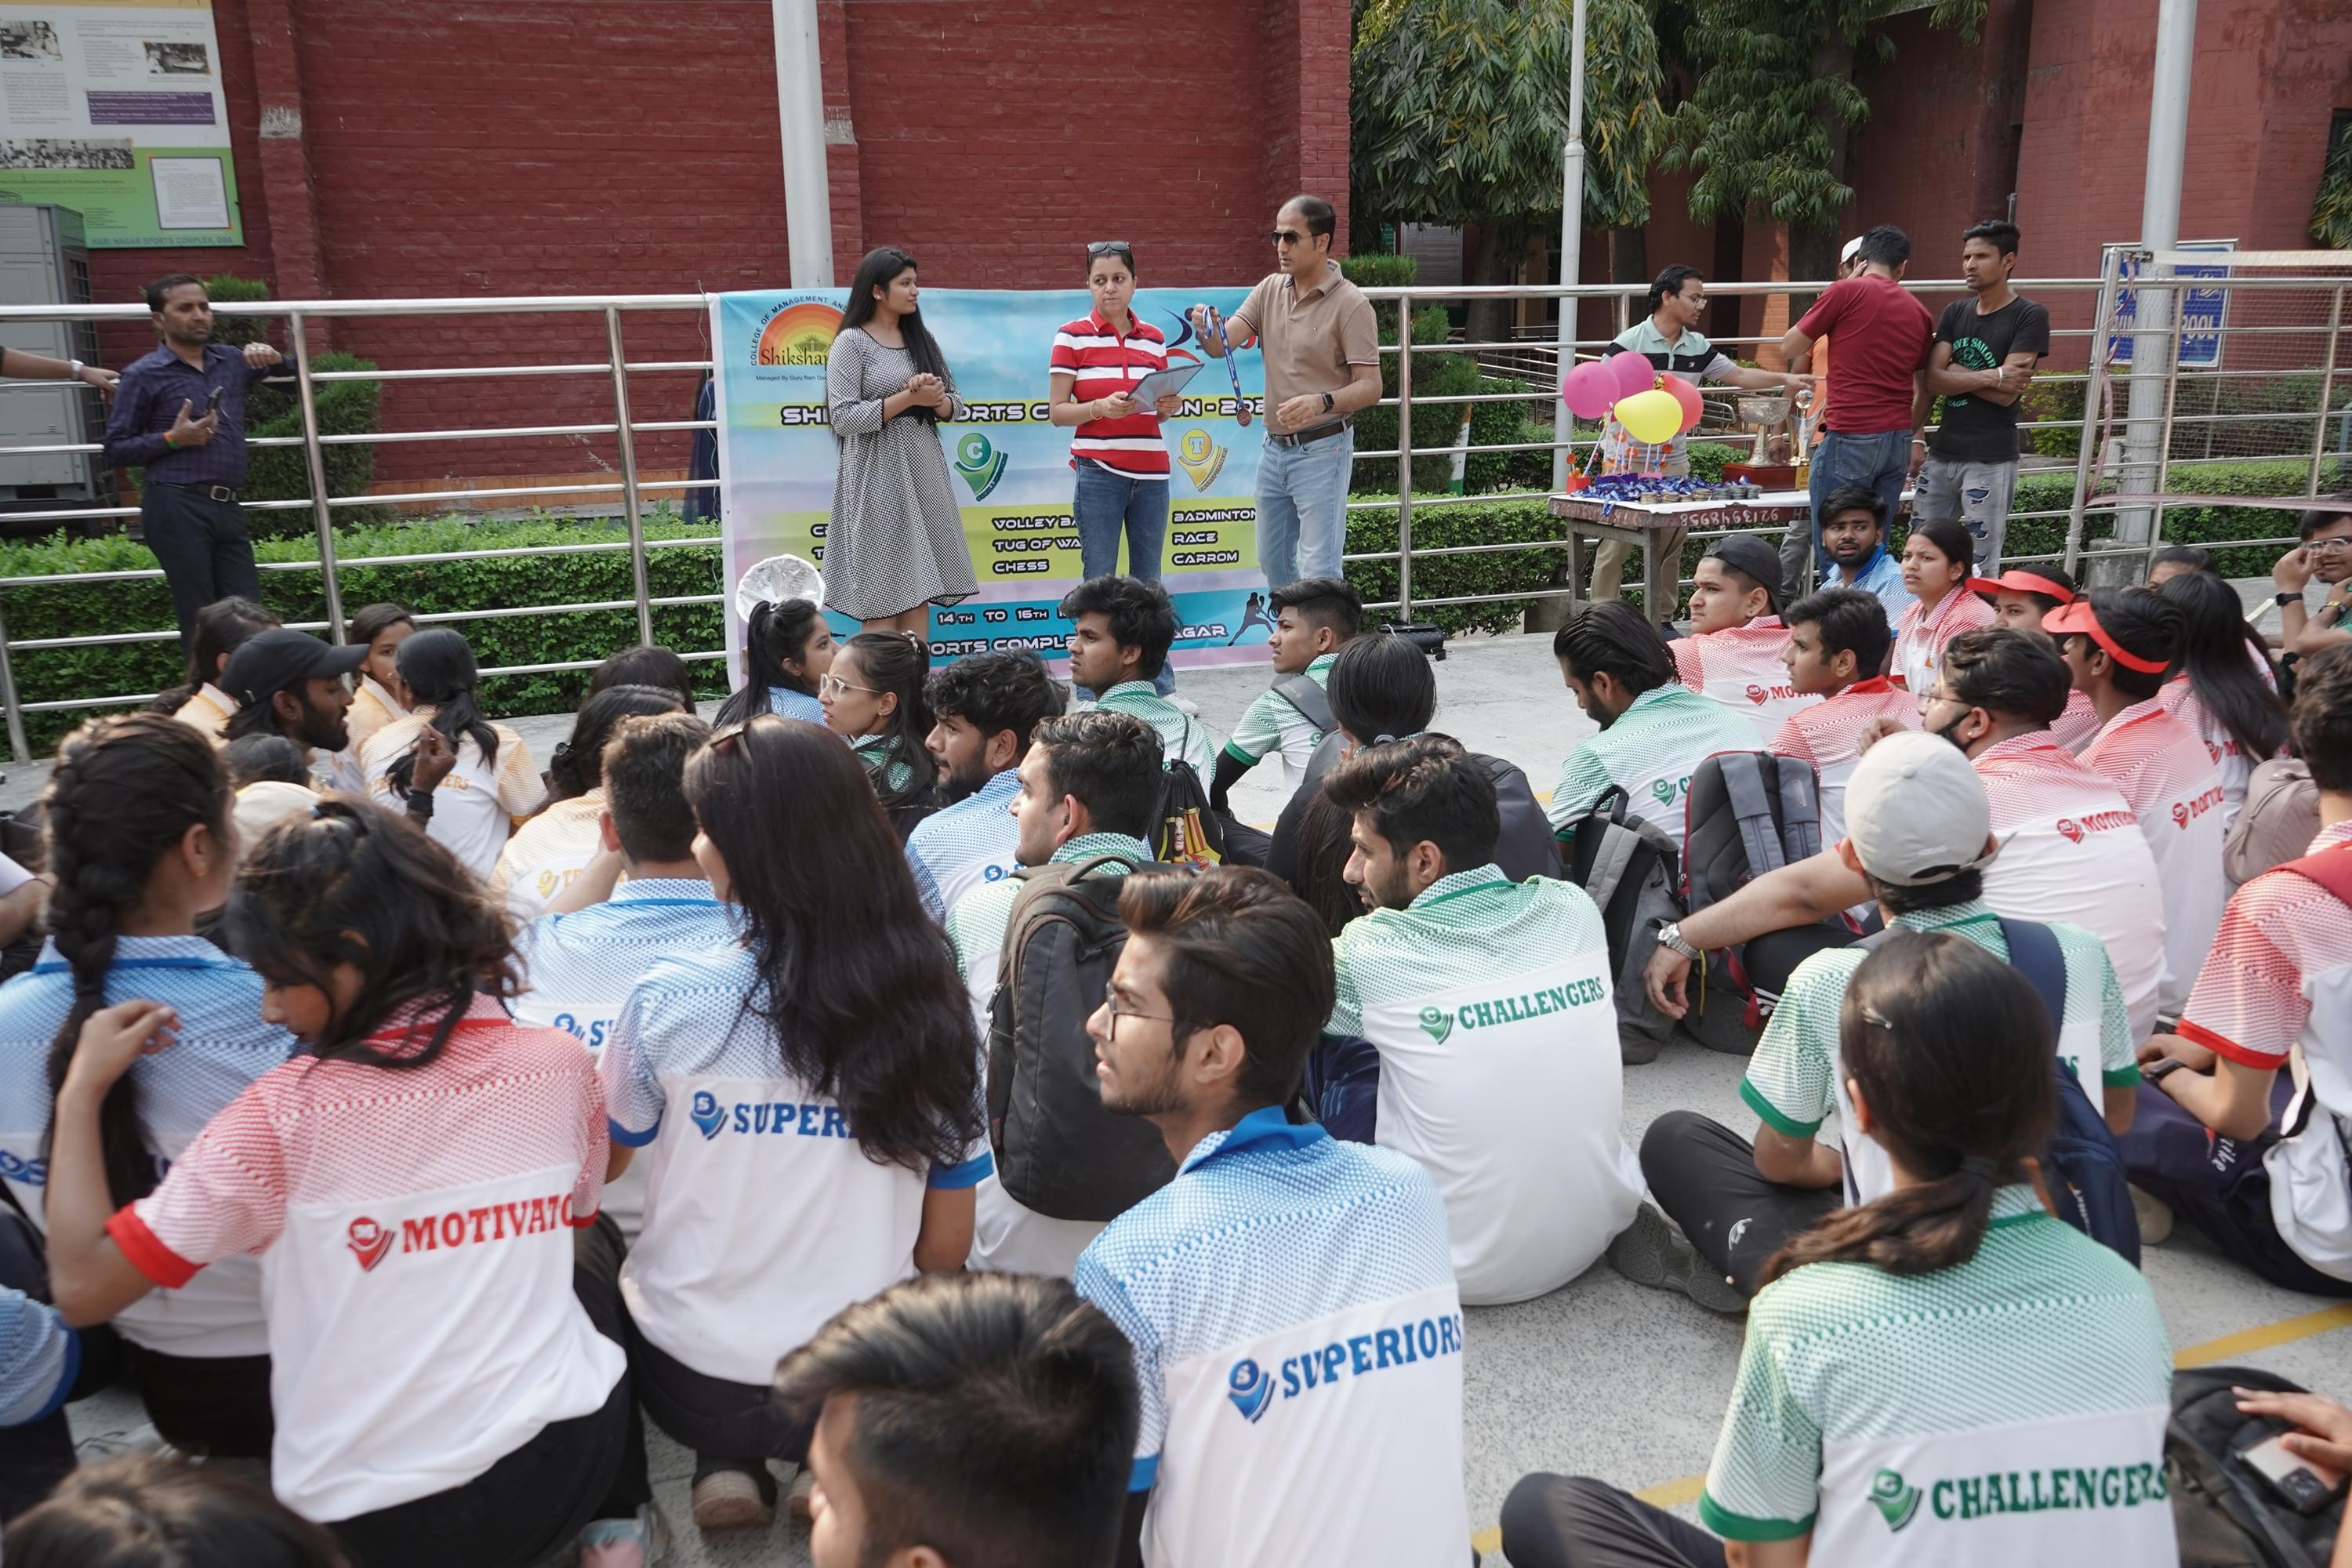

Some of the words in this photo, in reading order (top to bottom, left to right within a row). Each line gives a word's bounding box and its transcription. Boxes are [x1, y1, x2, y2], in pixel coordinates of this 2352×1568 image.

[750, 326, 763, 366] COLLEGE
[760, 313, 771, 325] OF
[771, 296, 828, 314] MANAGEMENT
[832, 300, 848, 312] AND
[1953, 337, 1970, 352] AVE
[957, 403, 1025, 423] ORTS
[992, 516, 1057, 531] VOLLEY
[993, 539, 1028, 553] TUG
[1029, 538, 1054, 551] OF
[1054, 536, 1082, 550] WA
[1172, 530, 1218, 545] RACE
[993, 559, 1050, 574] CHESS
[1172, 550, 1240, 566] CARROM
[983, 608, 1007, 623] TO
[1016, 608, 1049, 622] 16TH
[927, 639, 988, 656] ORTS
[1458, 976, 1605, 1029] CHALLENGERS
[734, 1102, 858, 1138] SUPER
[1281, 1312, 1462, 1399] SUPERIORS
[1932, 1463, 2169, 1519] CHALLENGERS
